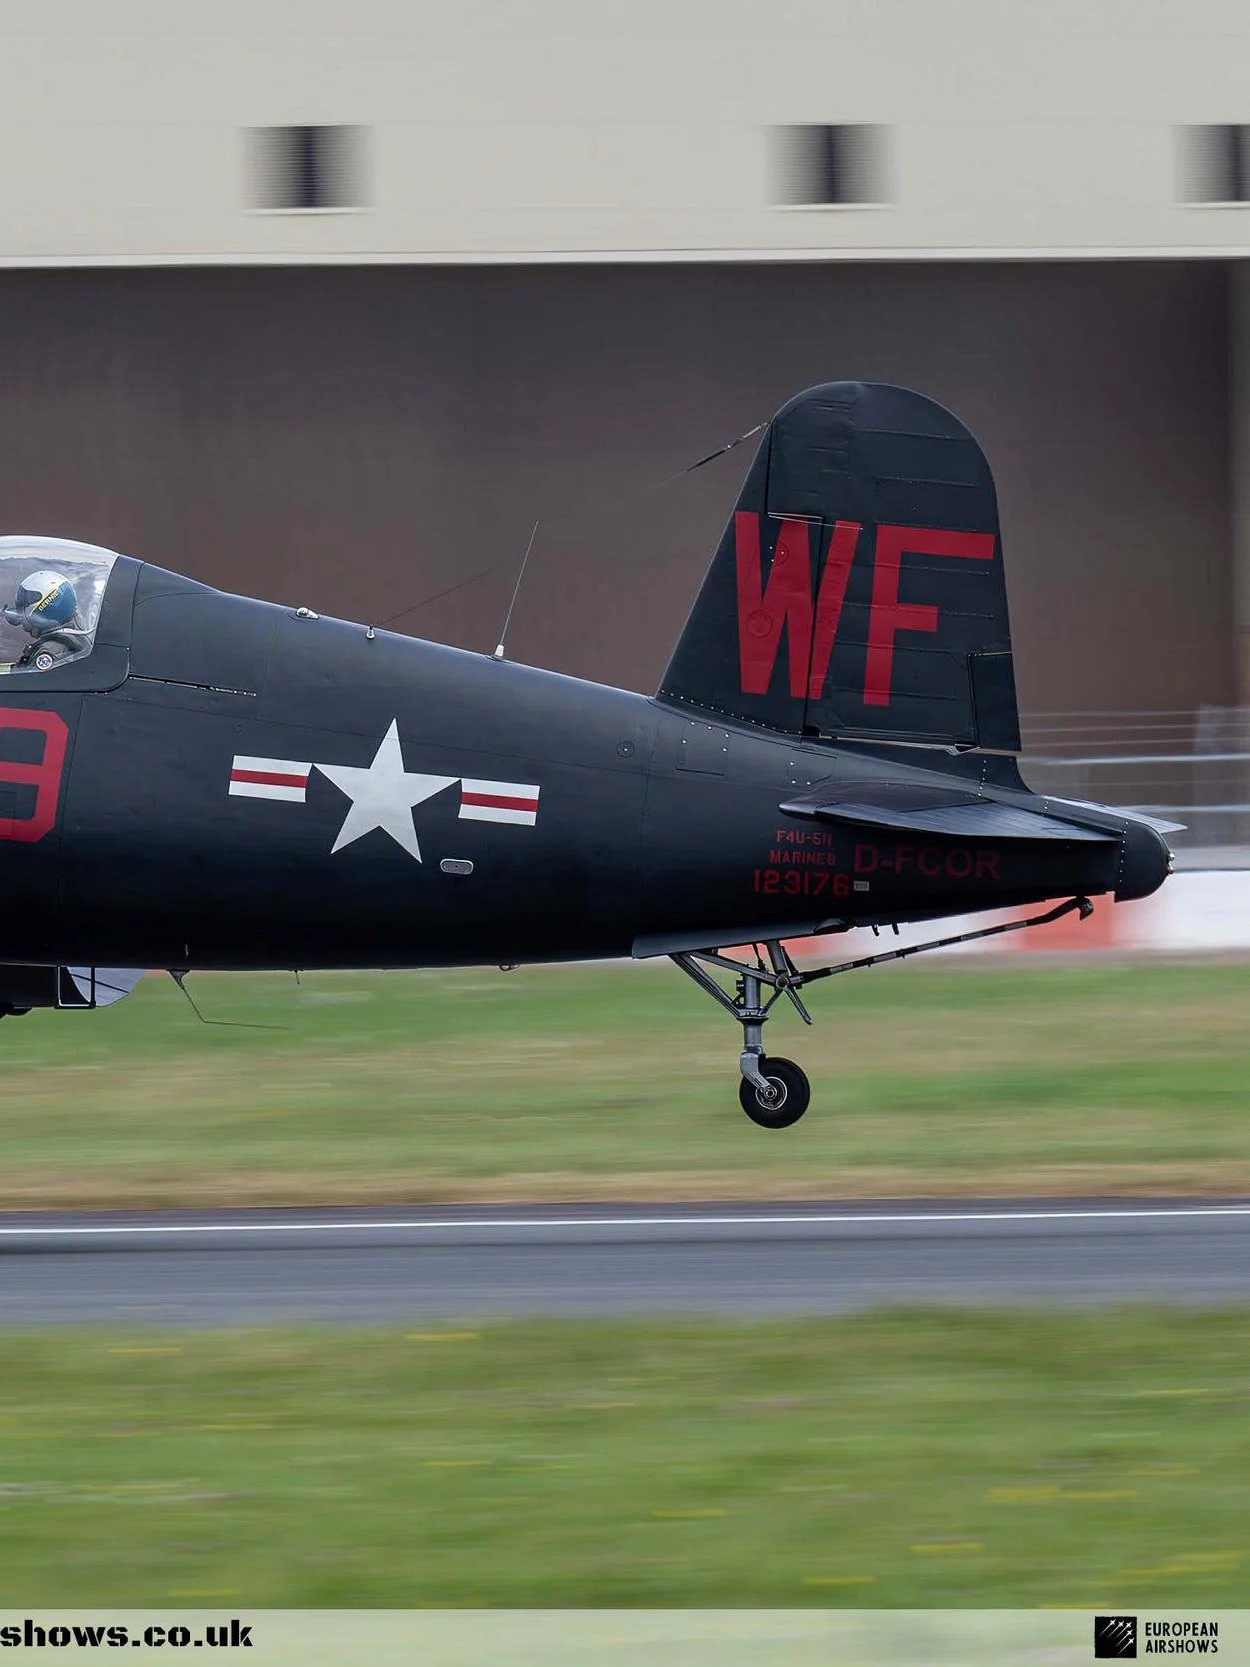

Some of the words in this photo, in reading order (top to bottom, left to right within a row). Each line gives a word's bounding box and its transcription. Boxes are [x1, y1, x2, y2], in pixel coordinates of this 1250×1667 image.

[735, 511, 996, 706] WF
[769, 849, 836, 866] MARINES
[854, 844, 1001, 880] D-FCOR
[753, 869, 850, 896] 123176
